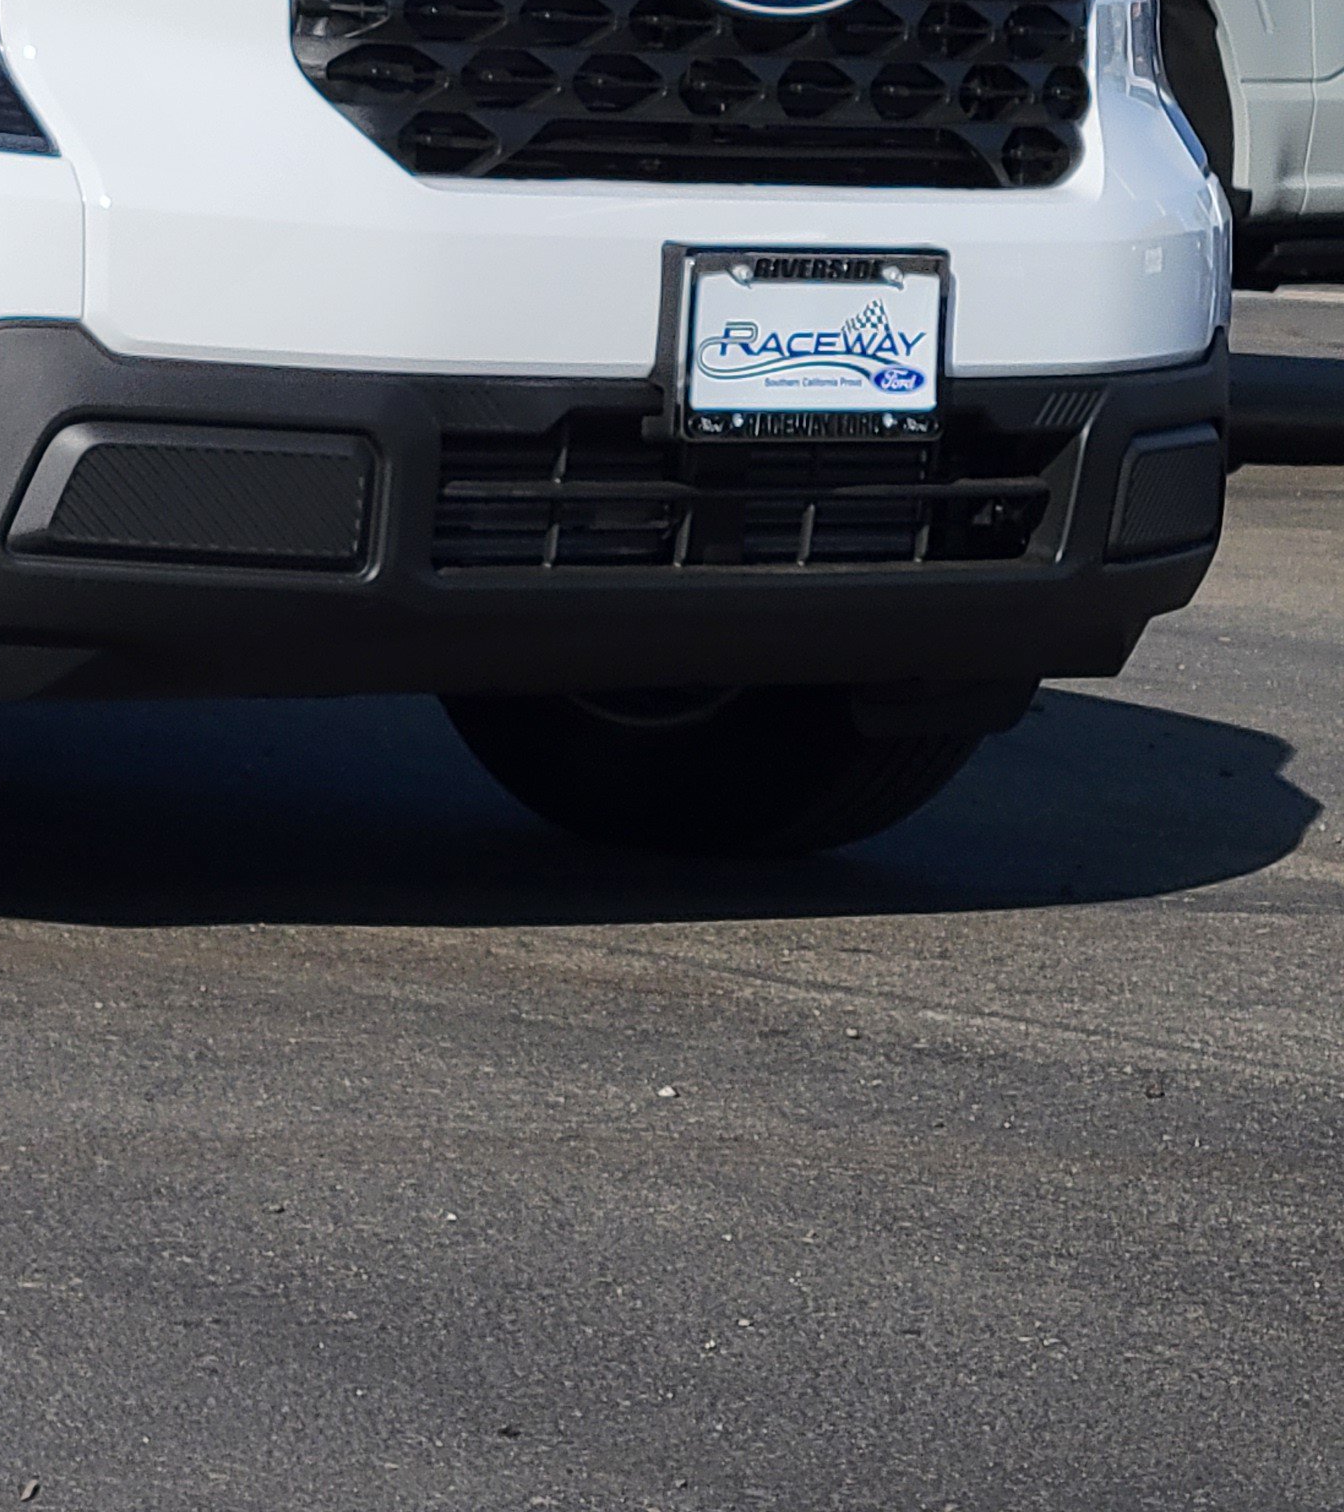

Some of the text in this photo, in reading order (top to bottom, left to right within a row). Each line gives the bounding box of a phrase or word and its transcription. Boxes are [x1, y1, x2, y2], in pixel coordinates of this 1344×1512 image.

[754, 257, 888, 279] RIVERSIDE
[719, 321, 927, 358] RACEWAY
[881, 370, 917, 390] Ford
